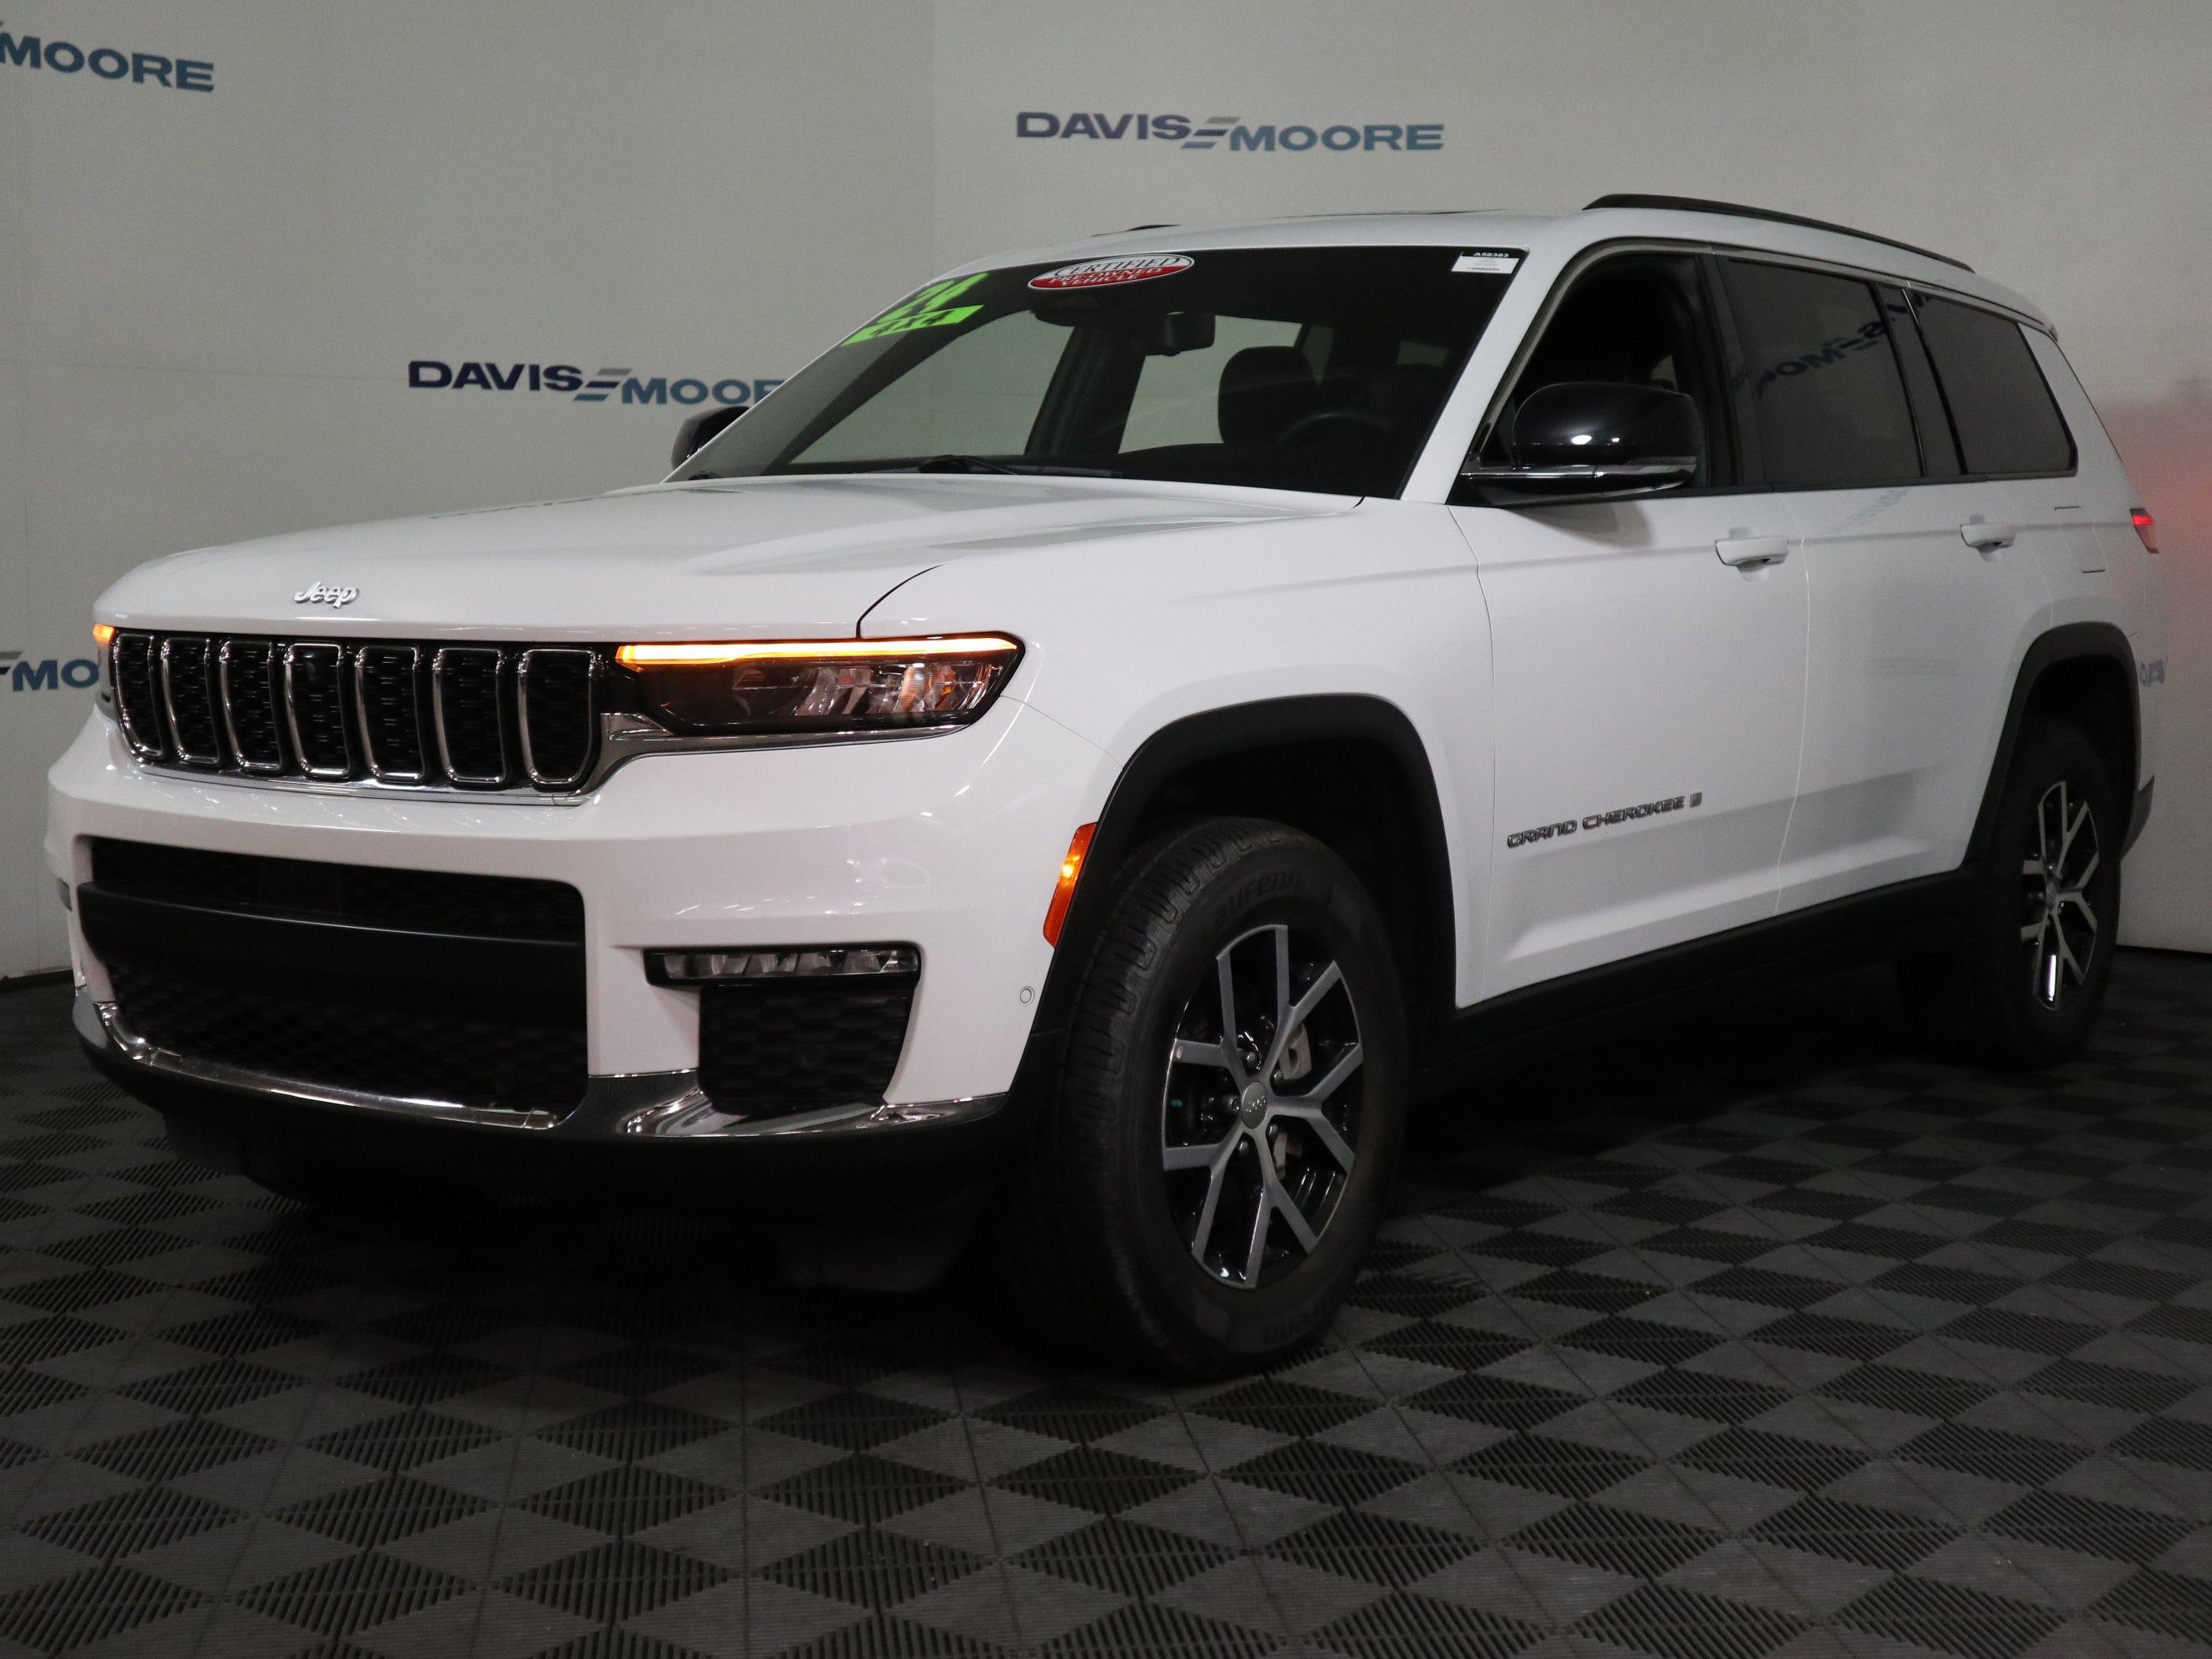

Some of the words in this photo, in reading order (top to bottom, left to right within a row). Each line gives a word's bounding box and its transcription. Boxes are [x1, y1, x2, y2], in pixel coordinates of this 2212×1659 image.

[0, 32, 214, 92] MOORE
[1016, 112, 1192, 140] DAVIS
[1229, 123, 1445, 152] MOORE
[1049, 267, 1163, 284] PRE-OWNED
[1054, 257, 1182, 276] CERTIFIED
[1061, 273, 1140, 286] VEHICLE
[408, 360, 584, 391] DAVIS
[294, 580, 360, 609] Jeep
[1507, 820, 1578, 849] GRAND
[1582, 795, 1686, 830] CHEROKEE
